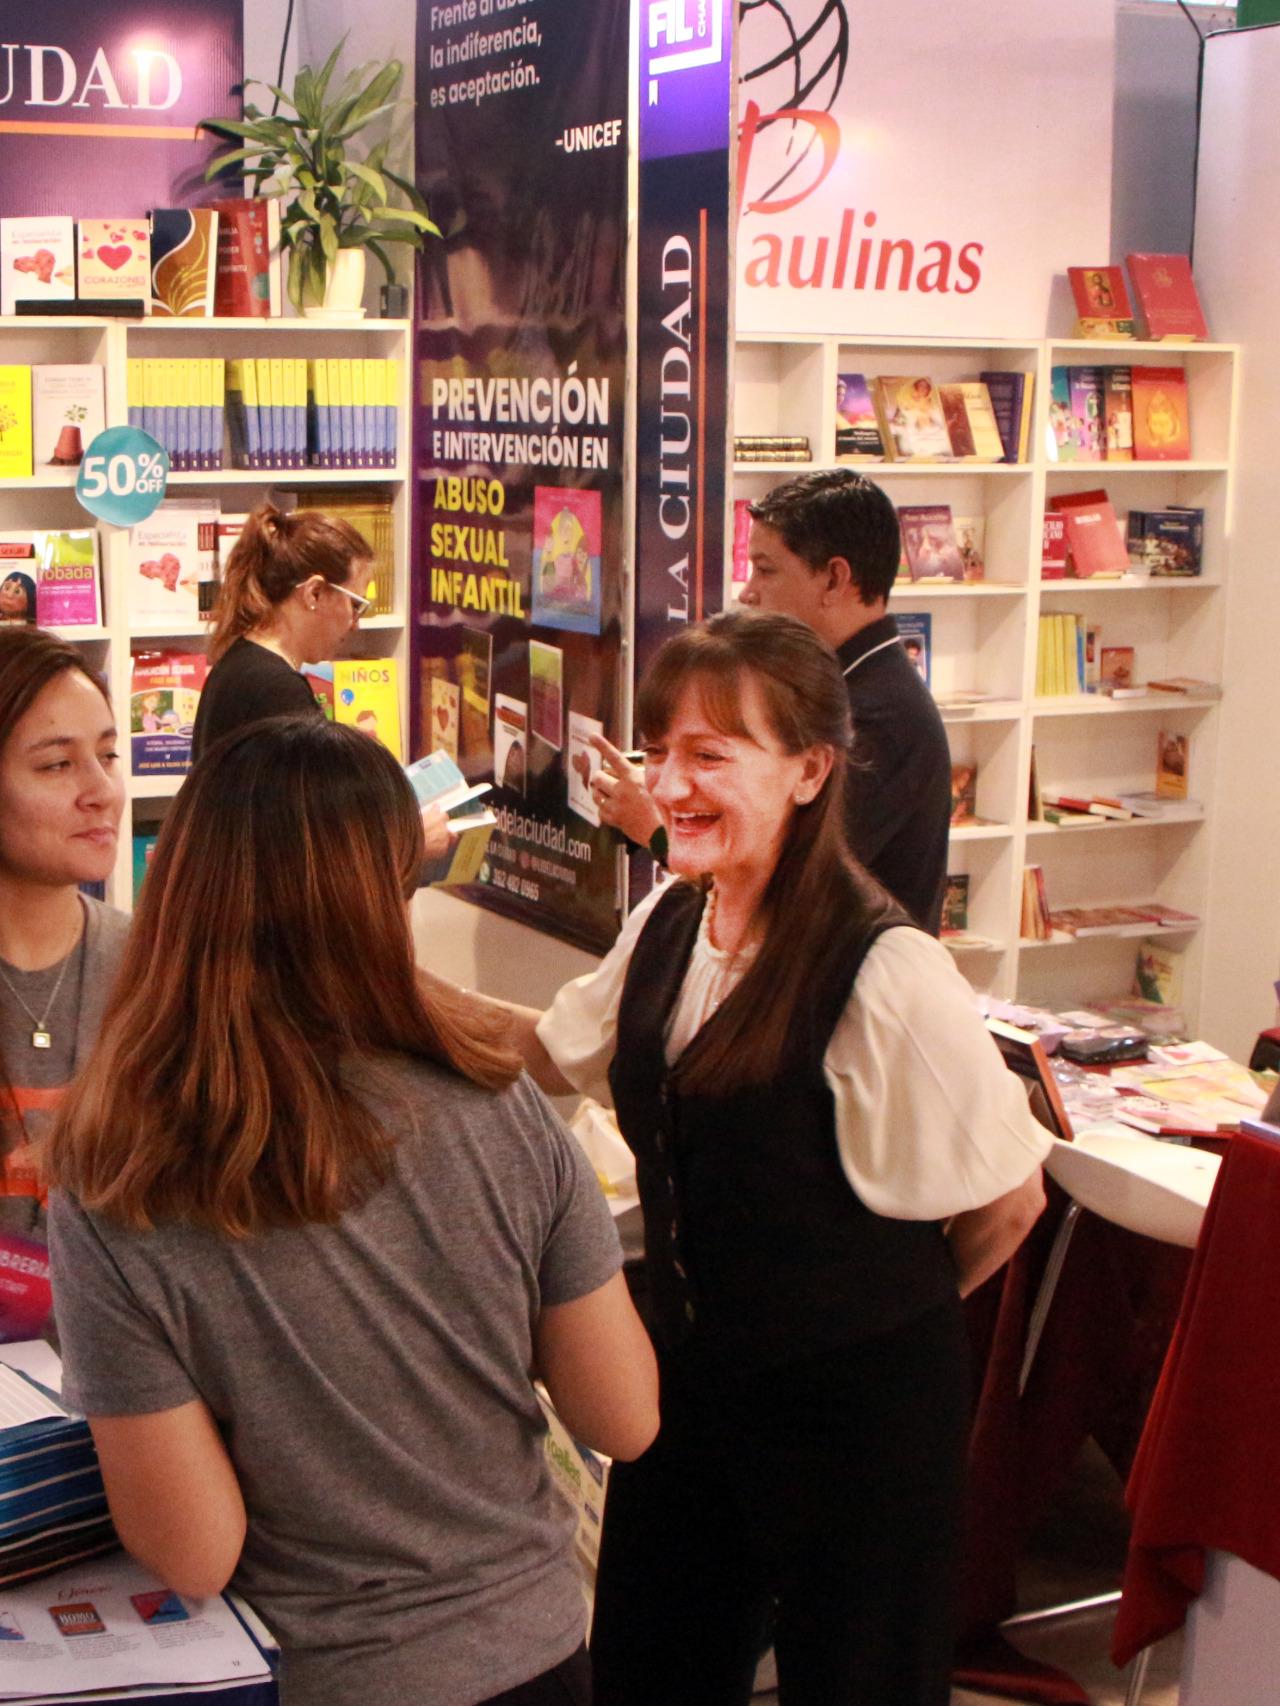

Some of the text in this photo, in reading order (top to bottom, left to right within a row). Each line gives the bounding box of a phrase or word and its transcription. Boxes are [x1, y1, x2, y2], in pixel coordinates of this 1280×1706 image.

[431, 0, 477, 31] Frente
[430, 16, 543, 70] la indiferencia,
[430, 58, 541, 109] es aceptación.
[554, 119, 623, 154] -UNICEF
[432, 360, 610, 425] PREVENCIÓN
[433, 425, 609, 470] E INTERVENCIÓN EN
[658, 235, 693, 623] LA CIUDAD
[81, 453, 164, 498] 50%
[135, 479, 164, 494] OFF
[433, 476, 506, 516] ABUSO
[430, 522, 510, 568] SEXUAL
[39, 565, 93, 580] robada
[431, 568, 525, 619] INFANTIL
[340, 667, 390, 684] NIÑOS
[488, 803, 592, 863] adelaciudad.com
